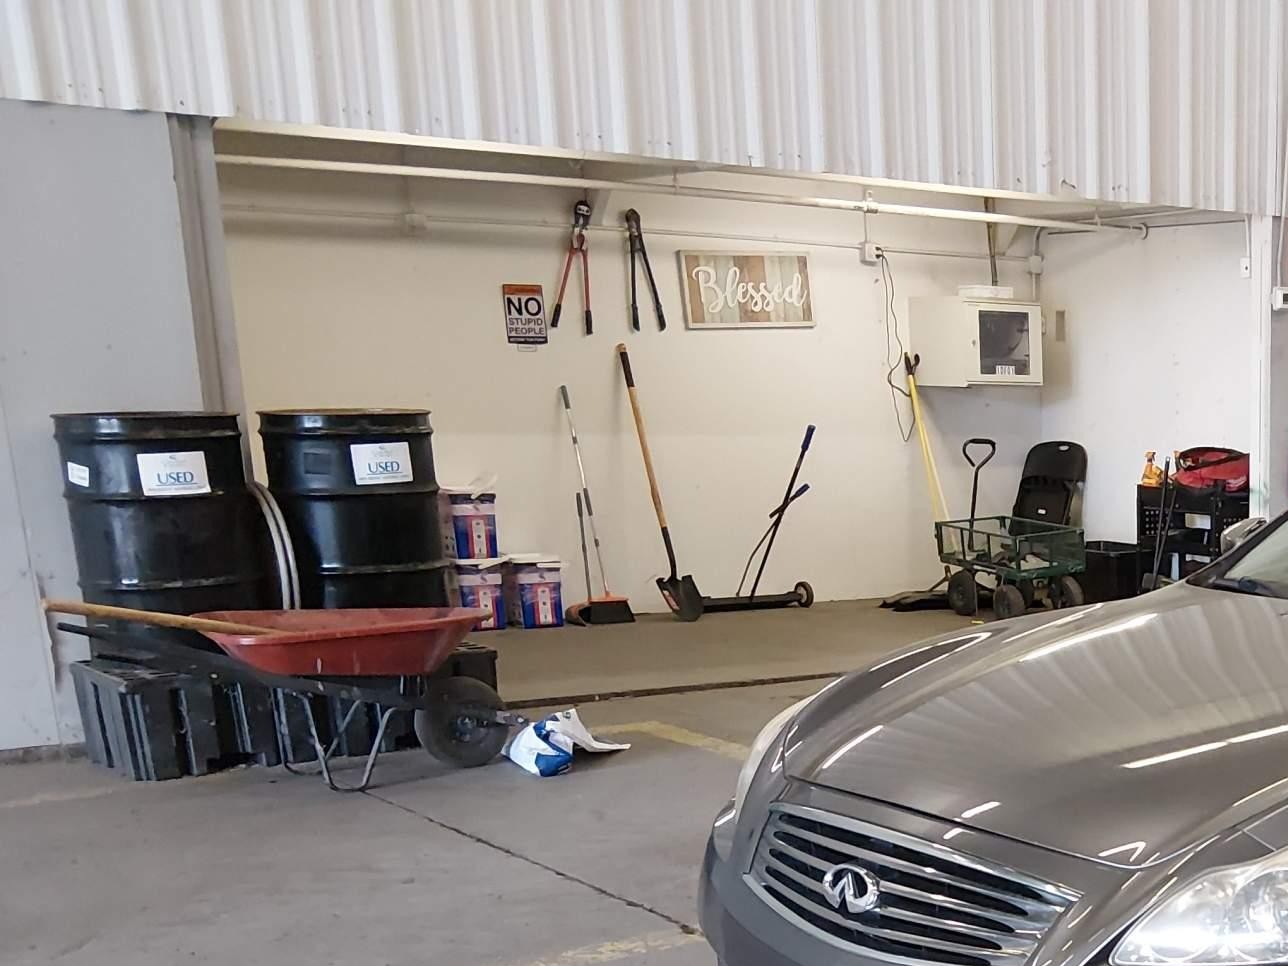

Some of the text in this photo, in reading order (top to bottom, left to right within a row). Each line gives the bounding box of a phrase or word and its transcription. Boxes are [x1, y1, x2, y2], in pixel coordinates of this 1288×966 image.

[692, 266, 808, 312] Blessed
[506, 297, 542, 317] NO
[508, 317, 543, 326] STUPID
[508, 327, 545, 336] PEOPLE
[367, 460, 401, 474] USED
[157, 471, 195, 485] USED
